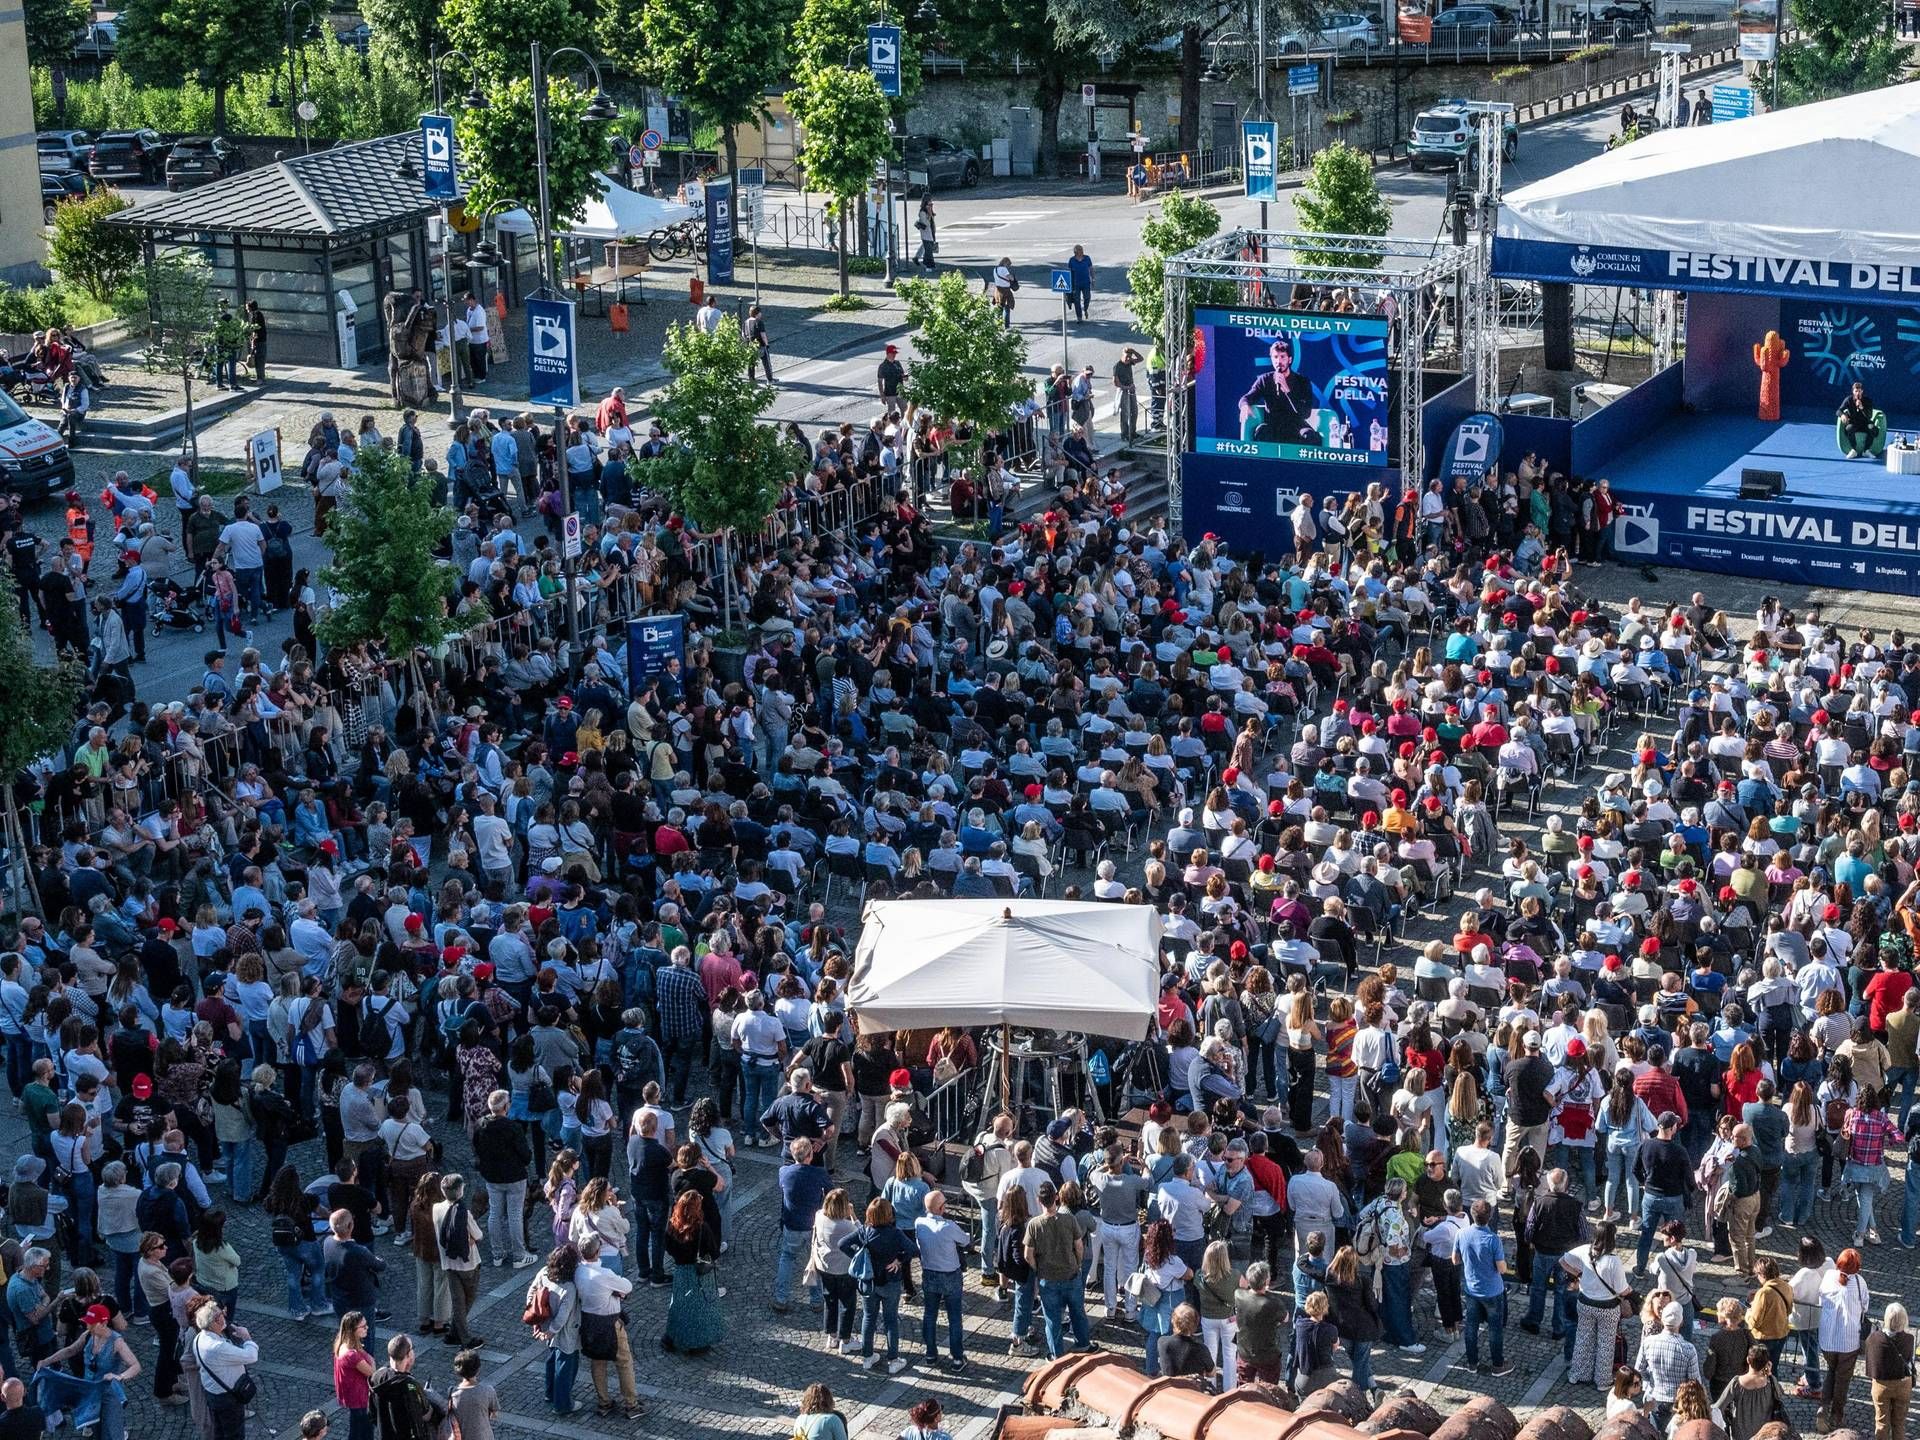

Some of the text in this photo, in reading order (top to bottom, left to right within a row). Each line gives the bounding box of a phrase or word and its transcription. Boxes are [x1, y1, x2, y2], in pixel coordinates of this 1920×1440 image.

[428, 160, 449, 168] FESTIVAL
[1597, 253, 1640, 263] COMUNE DI
[1597, 262, 1640, 273] DOGLIANI
[1668, 252, 1839, 288] FESTIVAL
[1229, 314, 1351, 332] FESTIVAL DELLA TV
[1799, 319, 1834, 328] FESTIVAL
[1245, 328, 1301, 339] DELLA TV
[1799, 326, 1822, 334] DELLA
[534, 357, 567, 368] FESTIVAL
[1851, 353, 1886, 362] FESTIVAL
[534, 365, 567, 375] DELLA TV
[1851, 361, 1886, 370] DELLA TV
[1334, 388, 1388, 402] DELLA T
[1216, 442, 1259, 455] #ftv25
[1299, 448, 1369, 463] #ritrovarsi
[260, 454, 277, 479] P1
[1452, 462, 1483, 470] FESTIVAL
[1217, 504, 1241, 513] FONDAZIONE
[1687, 506, 1920, 550] FESTIVAL DEL
[1881, 567, 1907, 576] Repubblica
